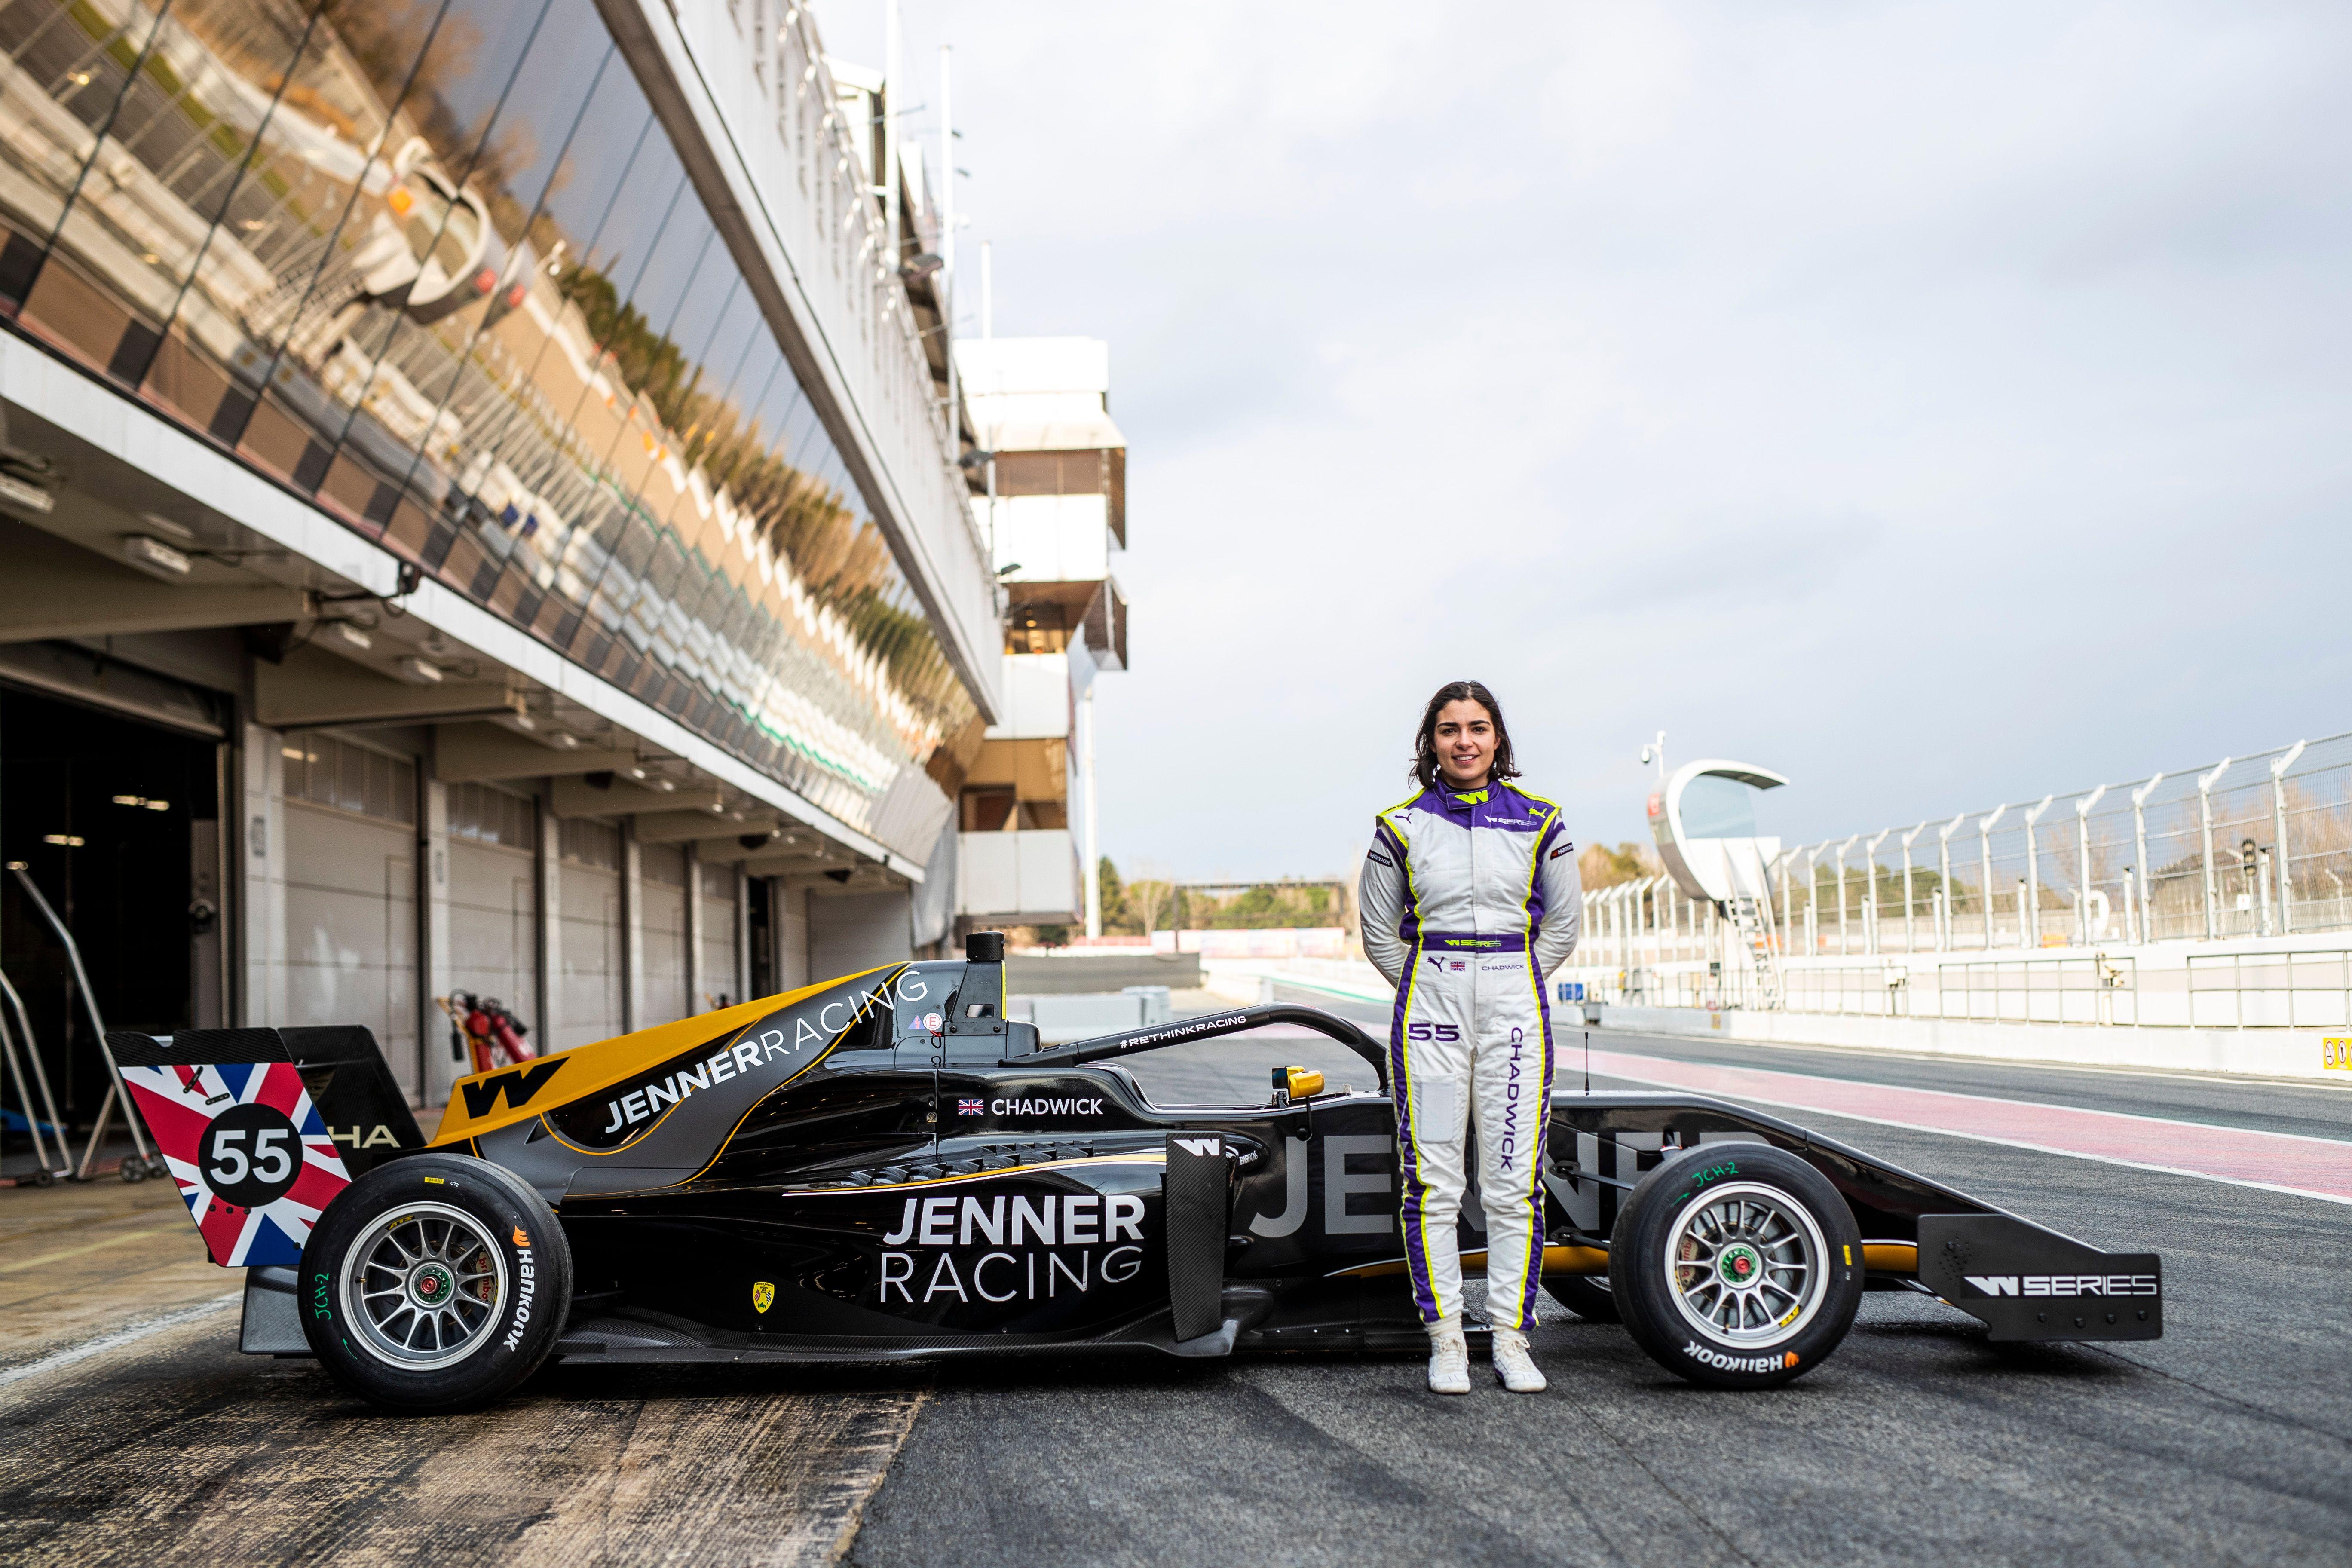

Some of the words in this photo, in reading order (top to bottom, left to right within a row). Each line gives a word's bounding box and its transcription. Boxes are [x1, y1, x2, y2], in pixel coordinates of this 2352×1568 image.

[929, 1017, 936, 1026] E
[1120, 1015, 1246, 1049] #RETHINKRACING
[1408, 1023, 1460, 1041] 55
[991, 1098, 1103, 1115] CHADWICK
[1501, 1026, 1523, 1171] CHADWICK
[209, 1128, 292, 1185] 55
[1692, 1161, 1739, 1187] JCH-2
[883, 1195, 1145, 1245] JENNER
[880, 1246, 1143, 1302] RACING
[2023, 1275, 2157, 1295] SERIES
[315, 1273, 331, 1320] JCH-2
[1683, 1339, 1783, 1373] Hankook
